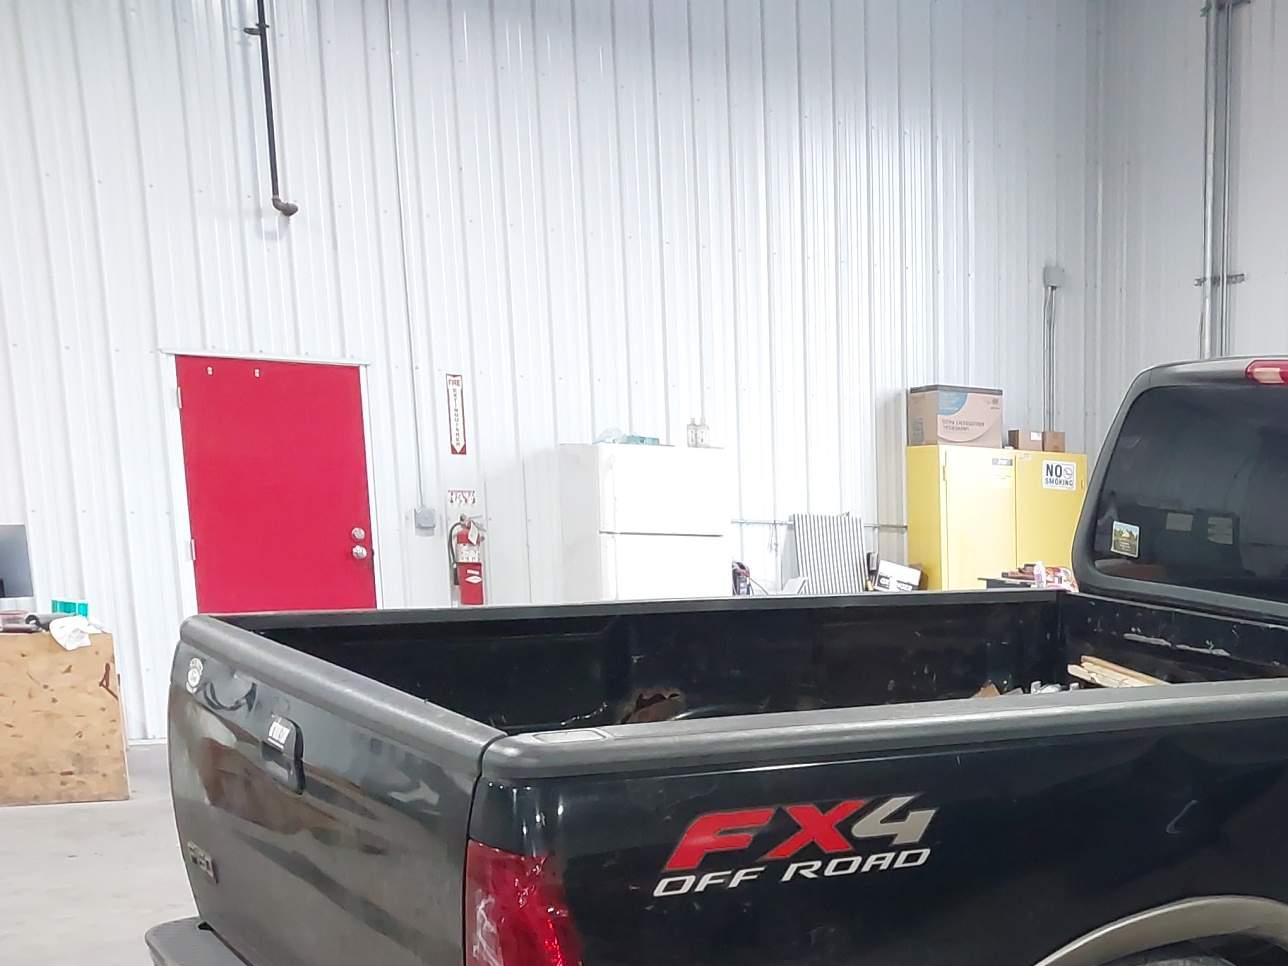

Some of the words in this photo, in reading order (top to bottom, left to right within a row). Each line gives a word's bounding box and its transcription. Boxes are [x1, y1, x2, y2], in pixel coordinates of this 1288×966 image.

[1045, 478, 1073, 486] SMOKING
[1046, 464, 1063, 478] NO
[664, 794, 938, 871] FX4
[652, 866, 766, 897] OFF
[780, 847, 931, 882] ROAD
